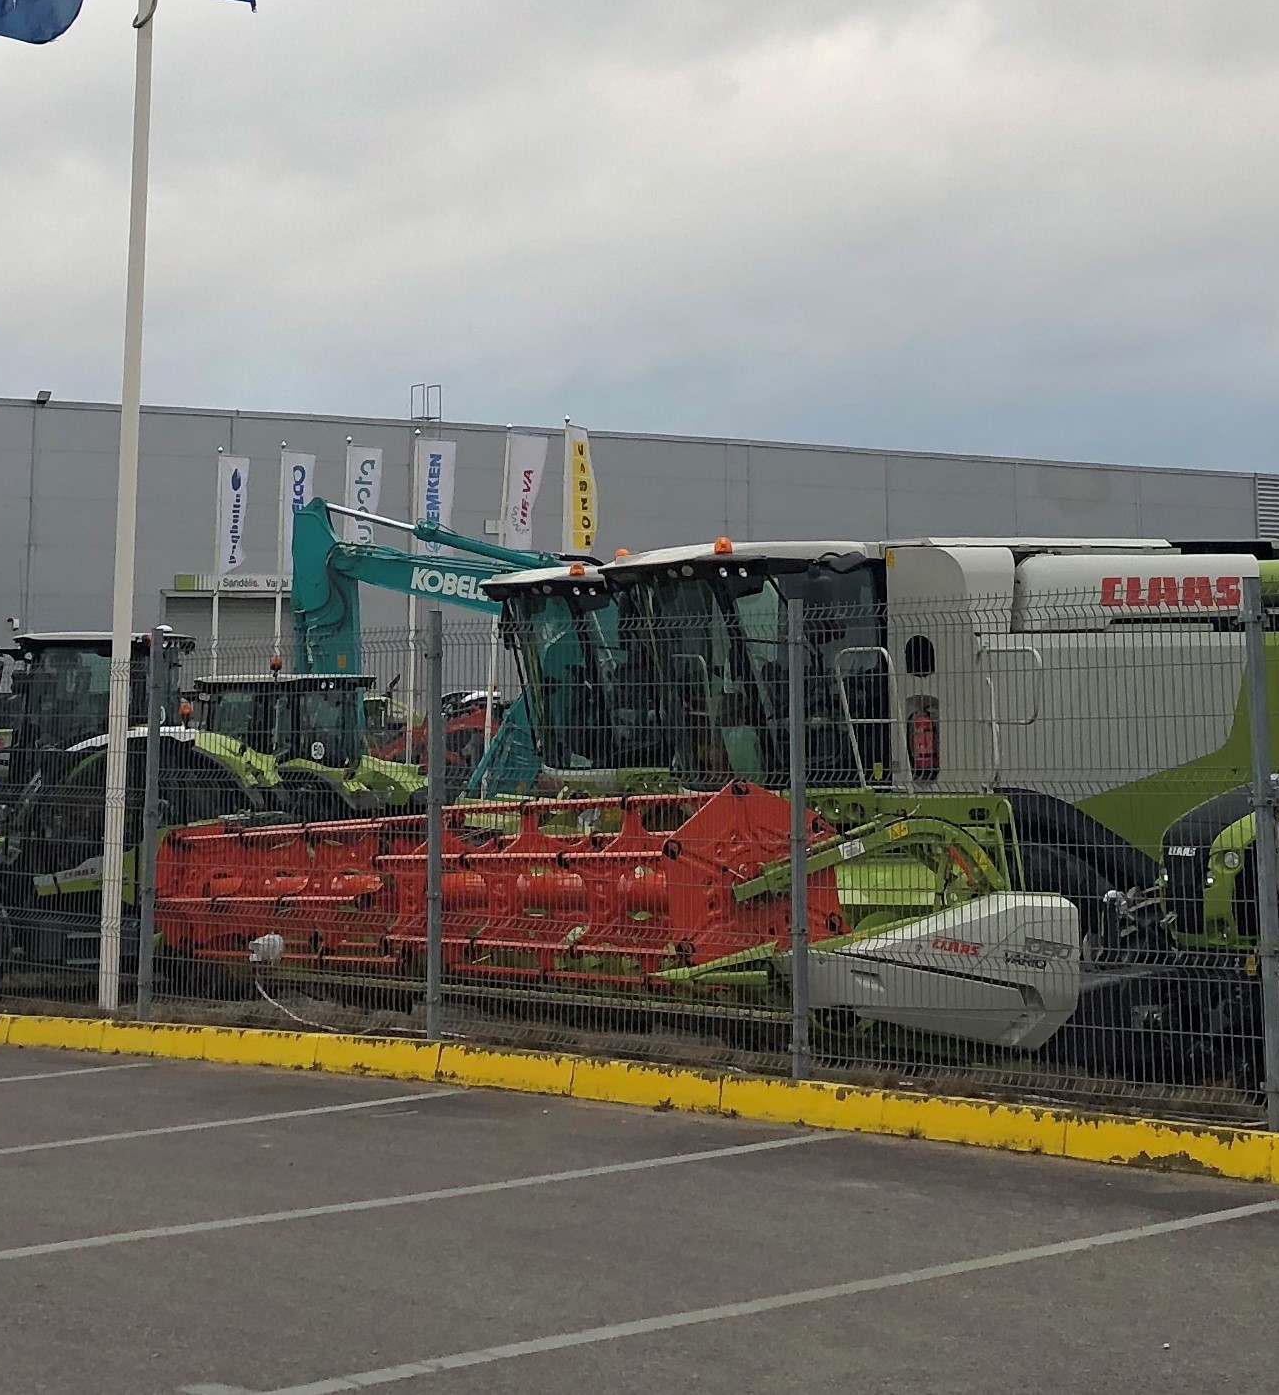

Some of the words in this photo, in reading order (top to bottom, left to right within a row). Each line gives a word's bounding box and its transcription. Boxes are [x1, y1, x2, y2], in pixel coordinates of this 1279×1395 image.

[425, 454, 442, 524] EMKEN
[1100, 576, 1241, 607] CLAAS
[931, 938, 980, 956] CLAAS
